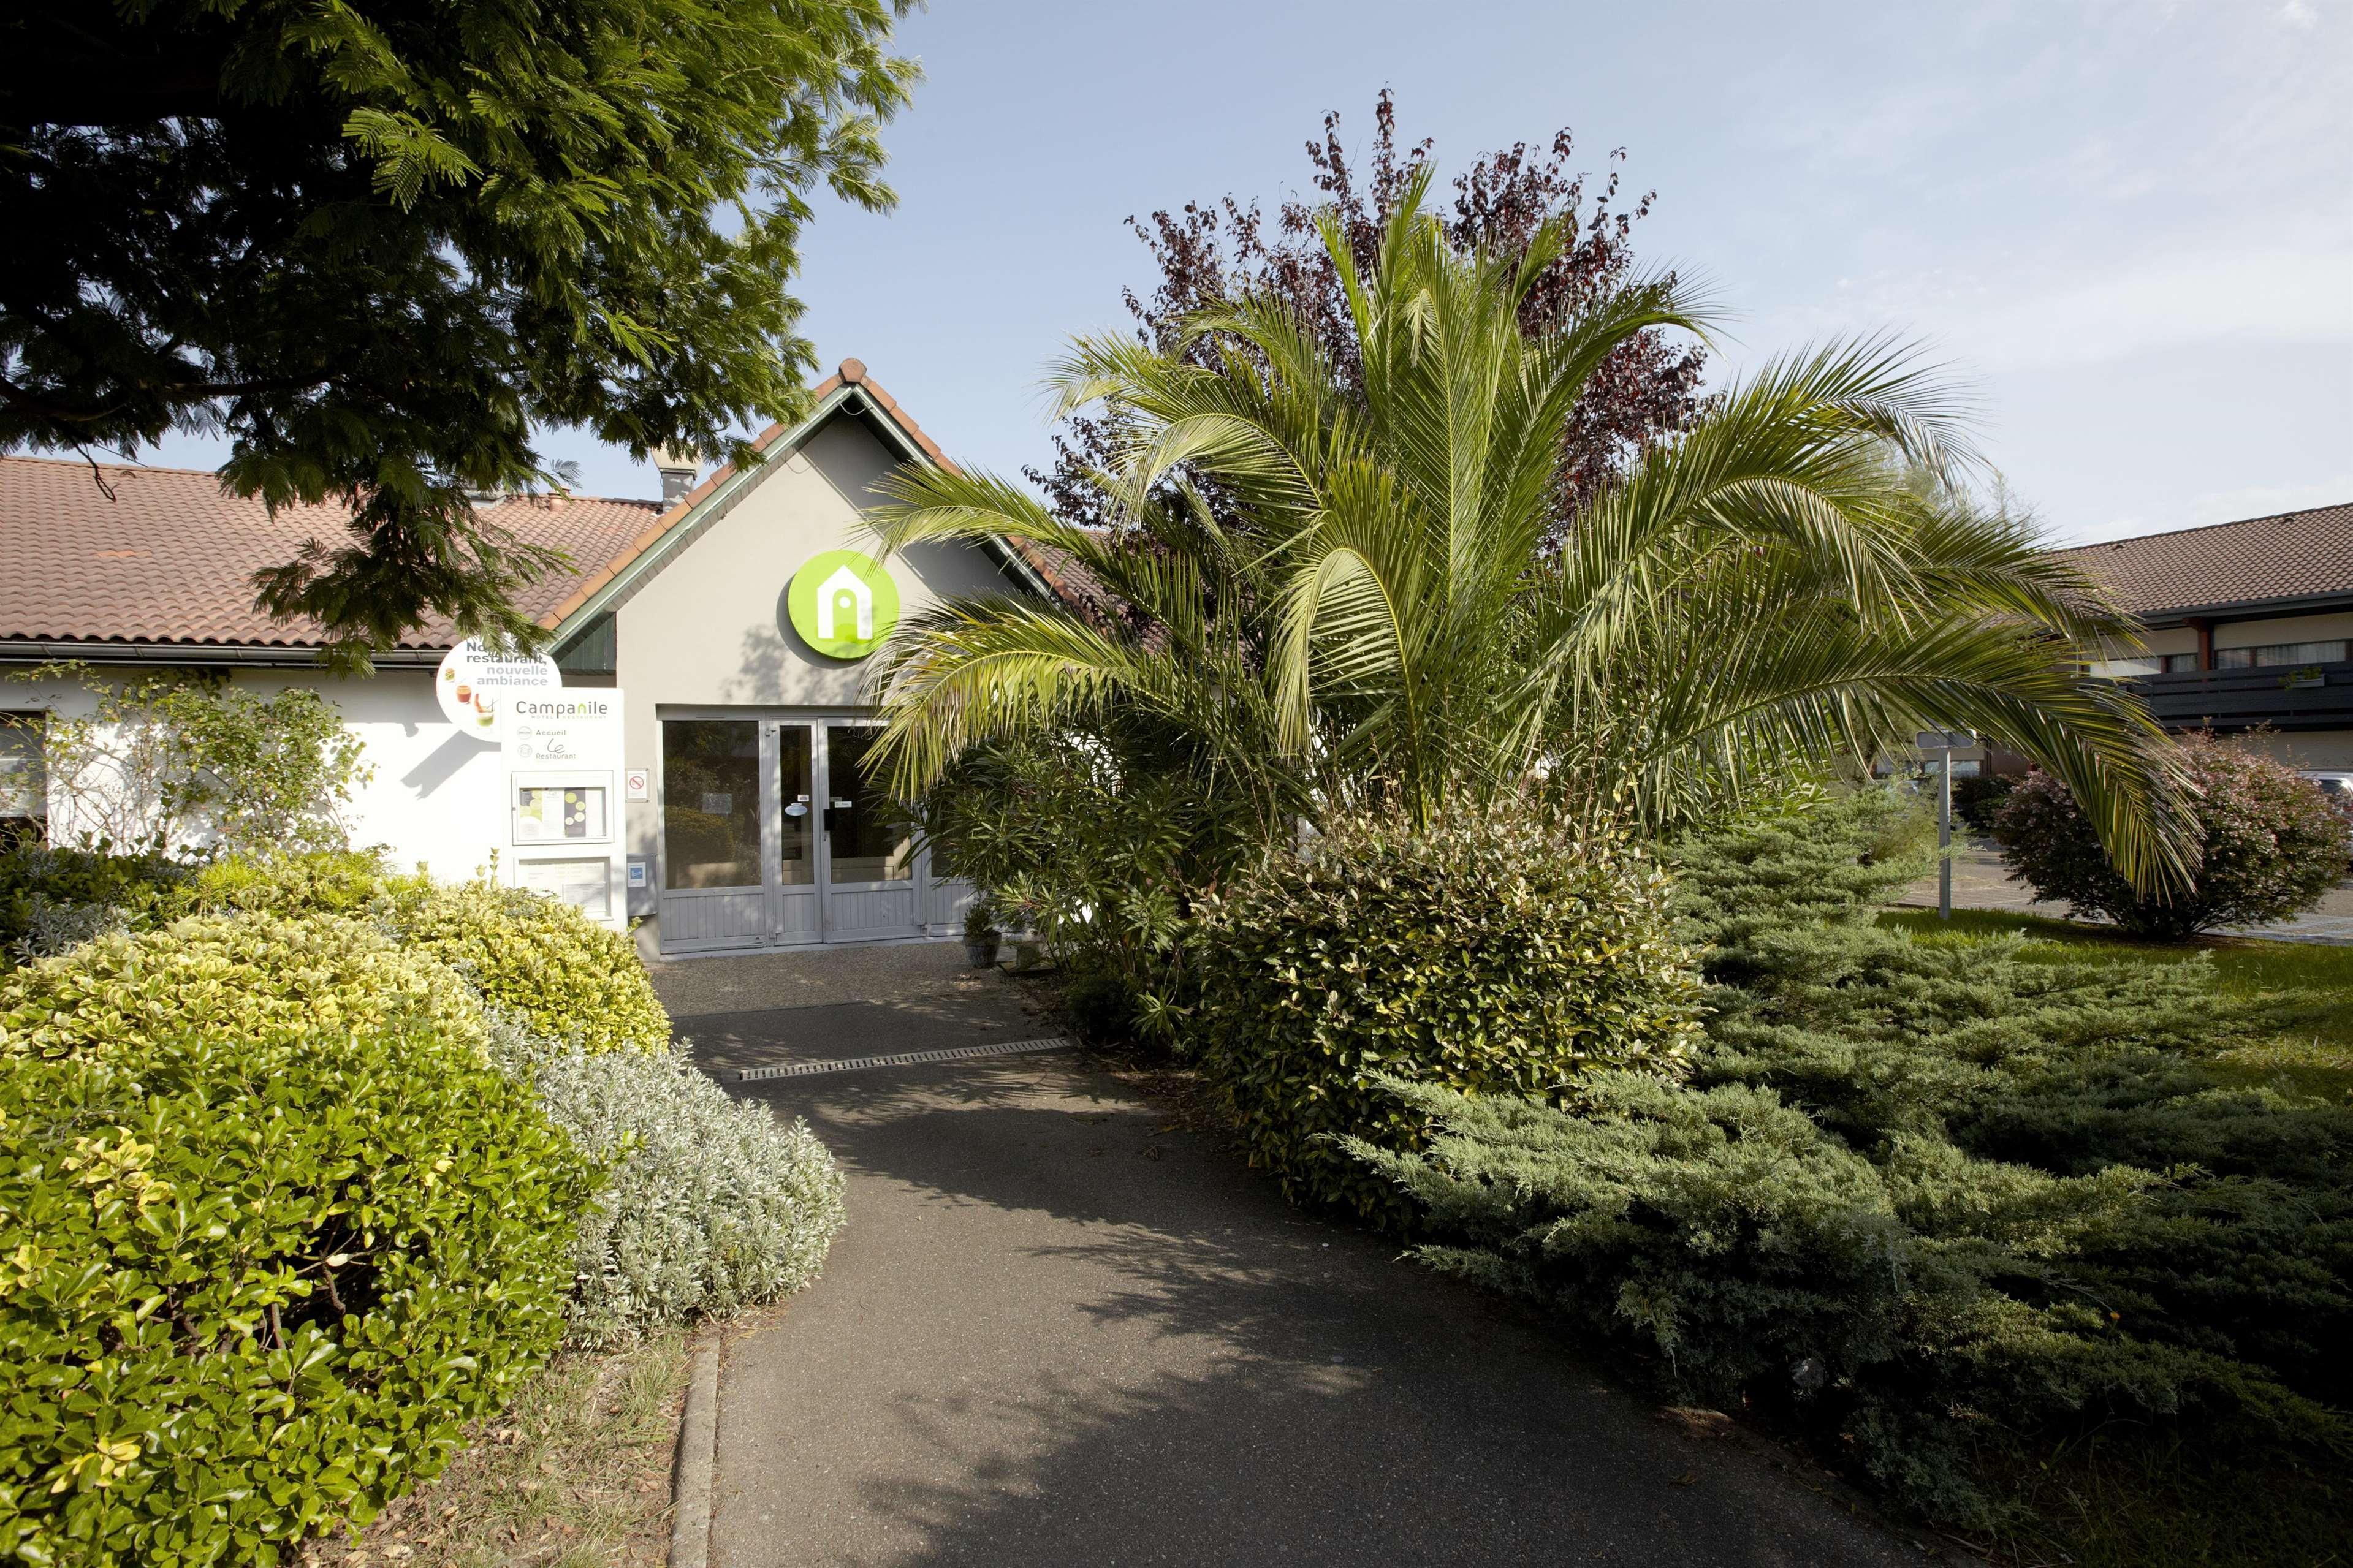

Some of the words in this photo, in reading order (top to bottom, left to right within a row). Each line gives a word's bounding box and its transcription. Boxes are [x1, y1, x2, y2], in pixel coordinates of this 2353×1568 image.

[487, 665, 547, 675] nouvelle
[477, 676, 547, 686] ambiance
[516, 701, 607, 719] Campanile
[547, 738, 565, 754] Le
